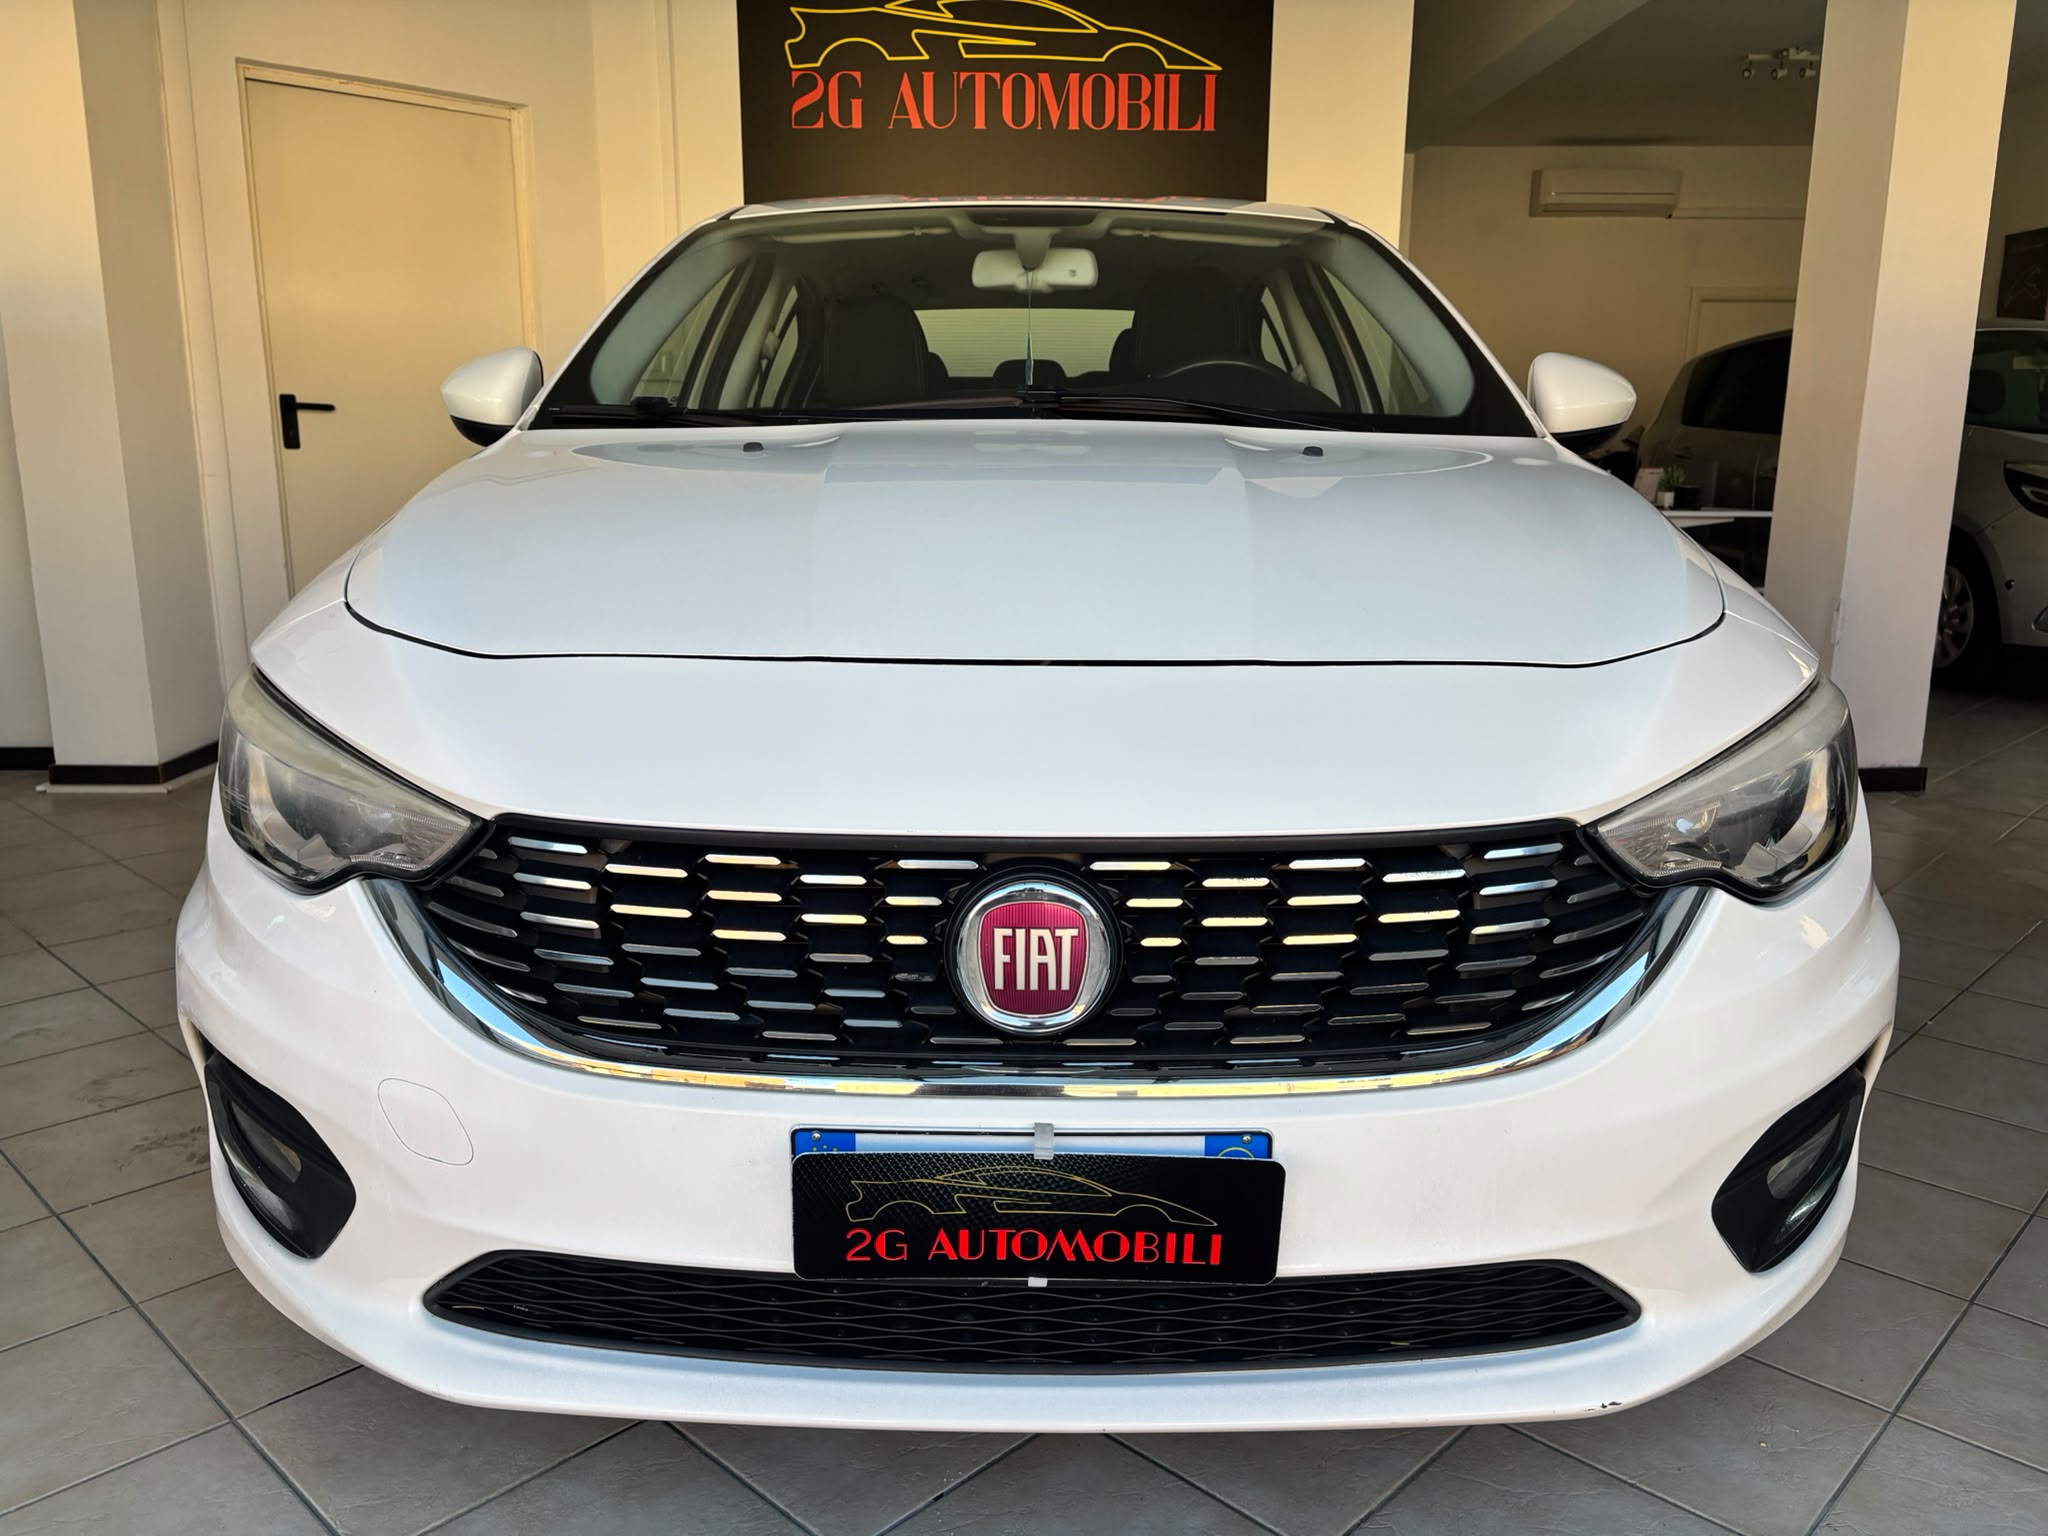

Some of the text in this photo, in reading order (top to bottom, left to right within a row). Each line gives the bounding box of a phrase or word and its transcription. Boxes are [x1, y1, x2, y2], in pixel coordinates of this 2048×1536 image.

[791, 70, 1217, 131] 2G AUTOMOBILI
[993, 927, 1079, 991] FIAT
[845, 1228, 1222, 1266] 2G AUTOMOBILI
